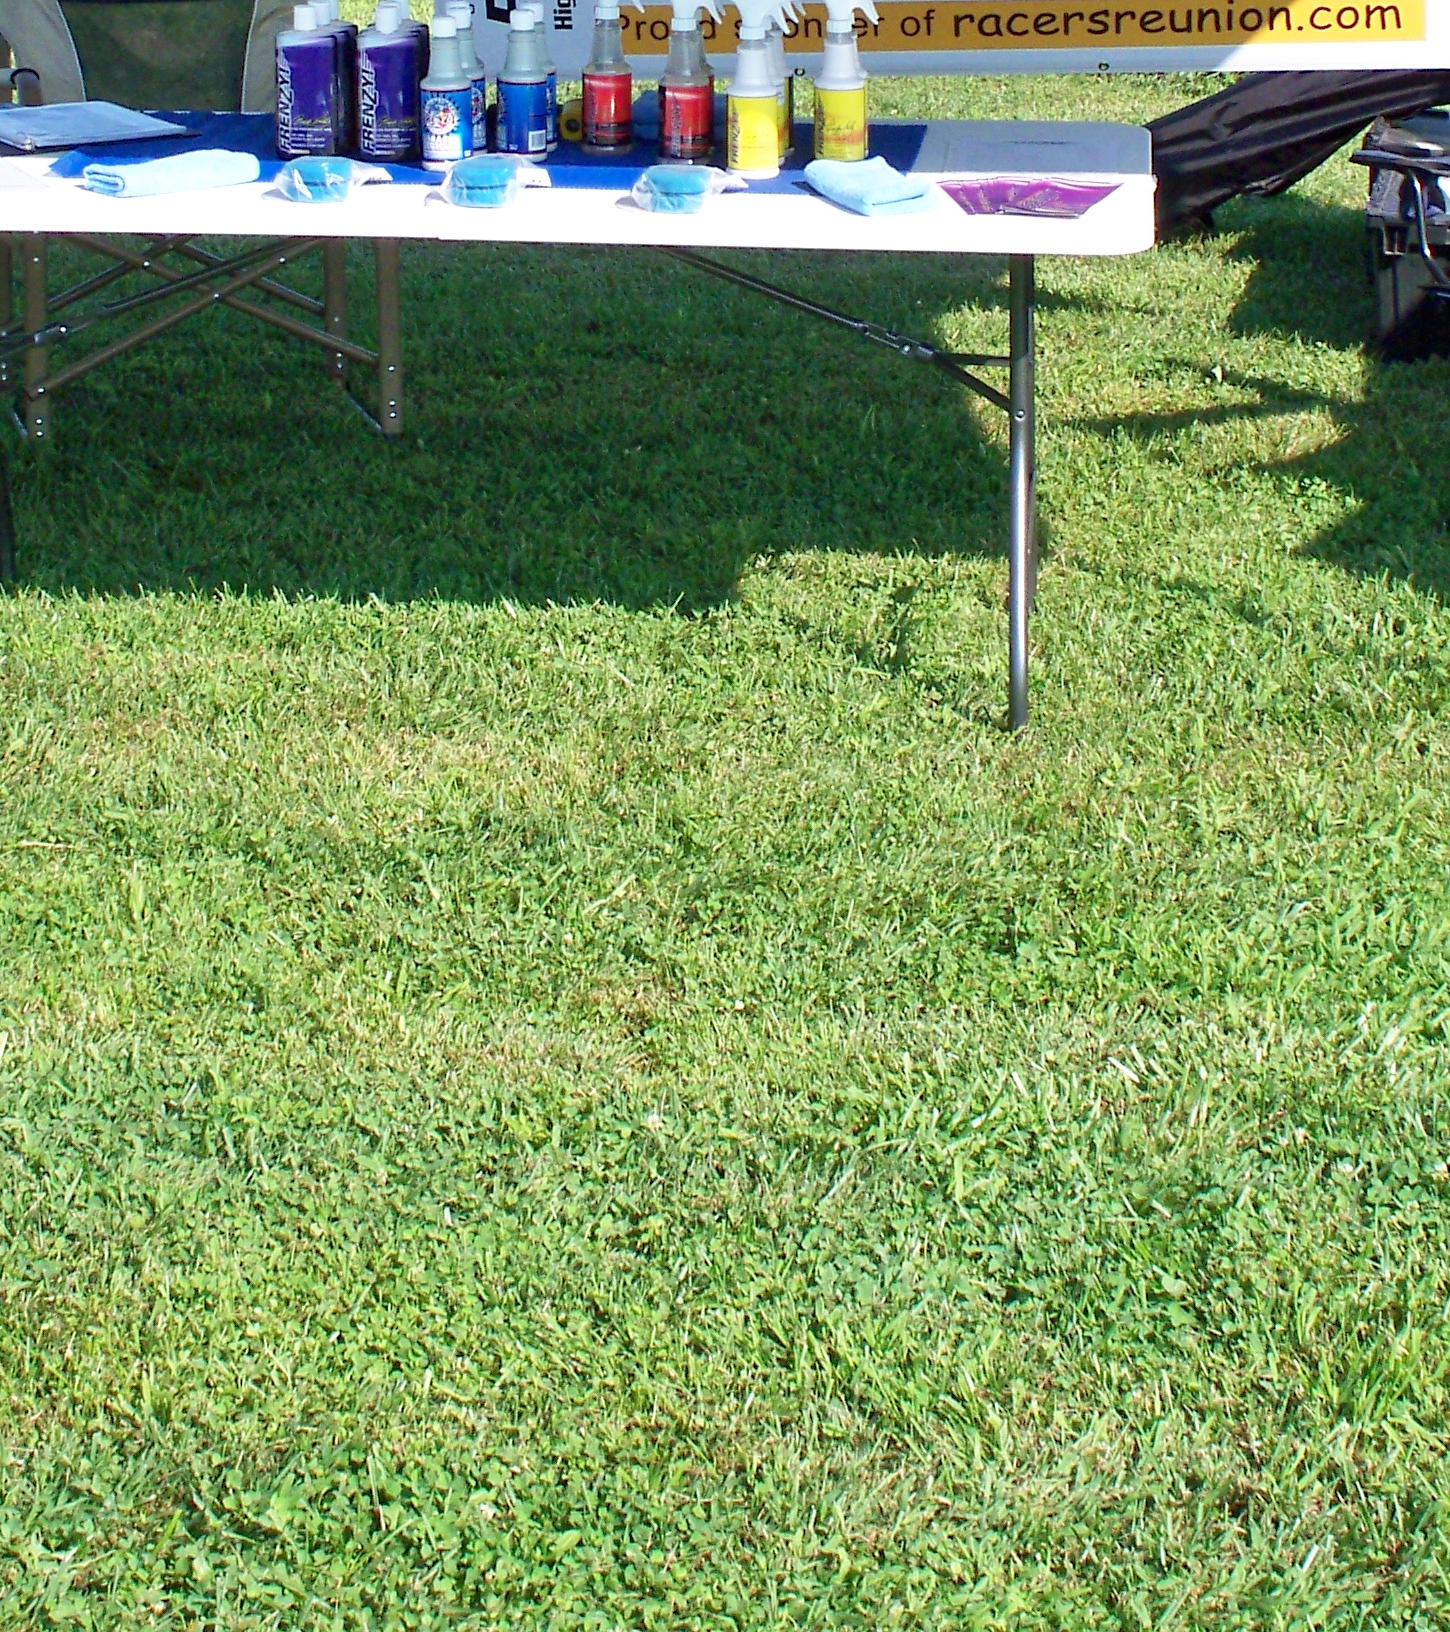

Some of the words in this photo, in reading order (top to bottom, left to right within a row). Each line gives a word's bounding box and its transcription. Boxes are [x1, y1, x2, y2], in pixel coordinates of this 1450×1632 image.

[619, 13, 717, 41] Prod
[900, 9, 936, 37] of
[953, 0, 1403, 39] racersreunion.com
